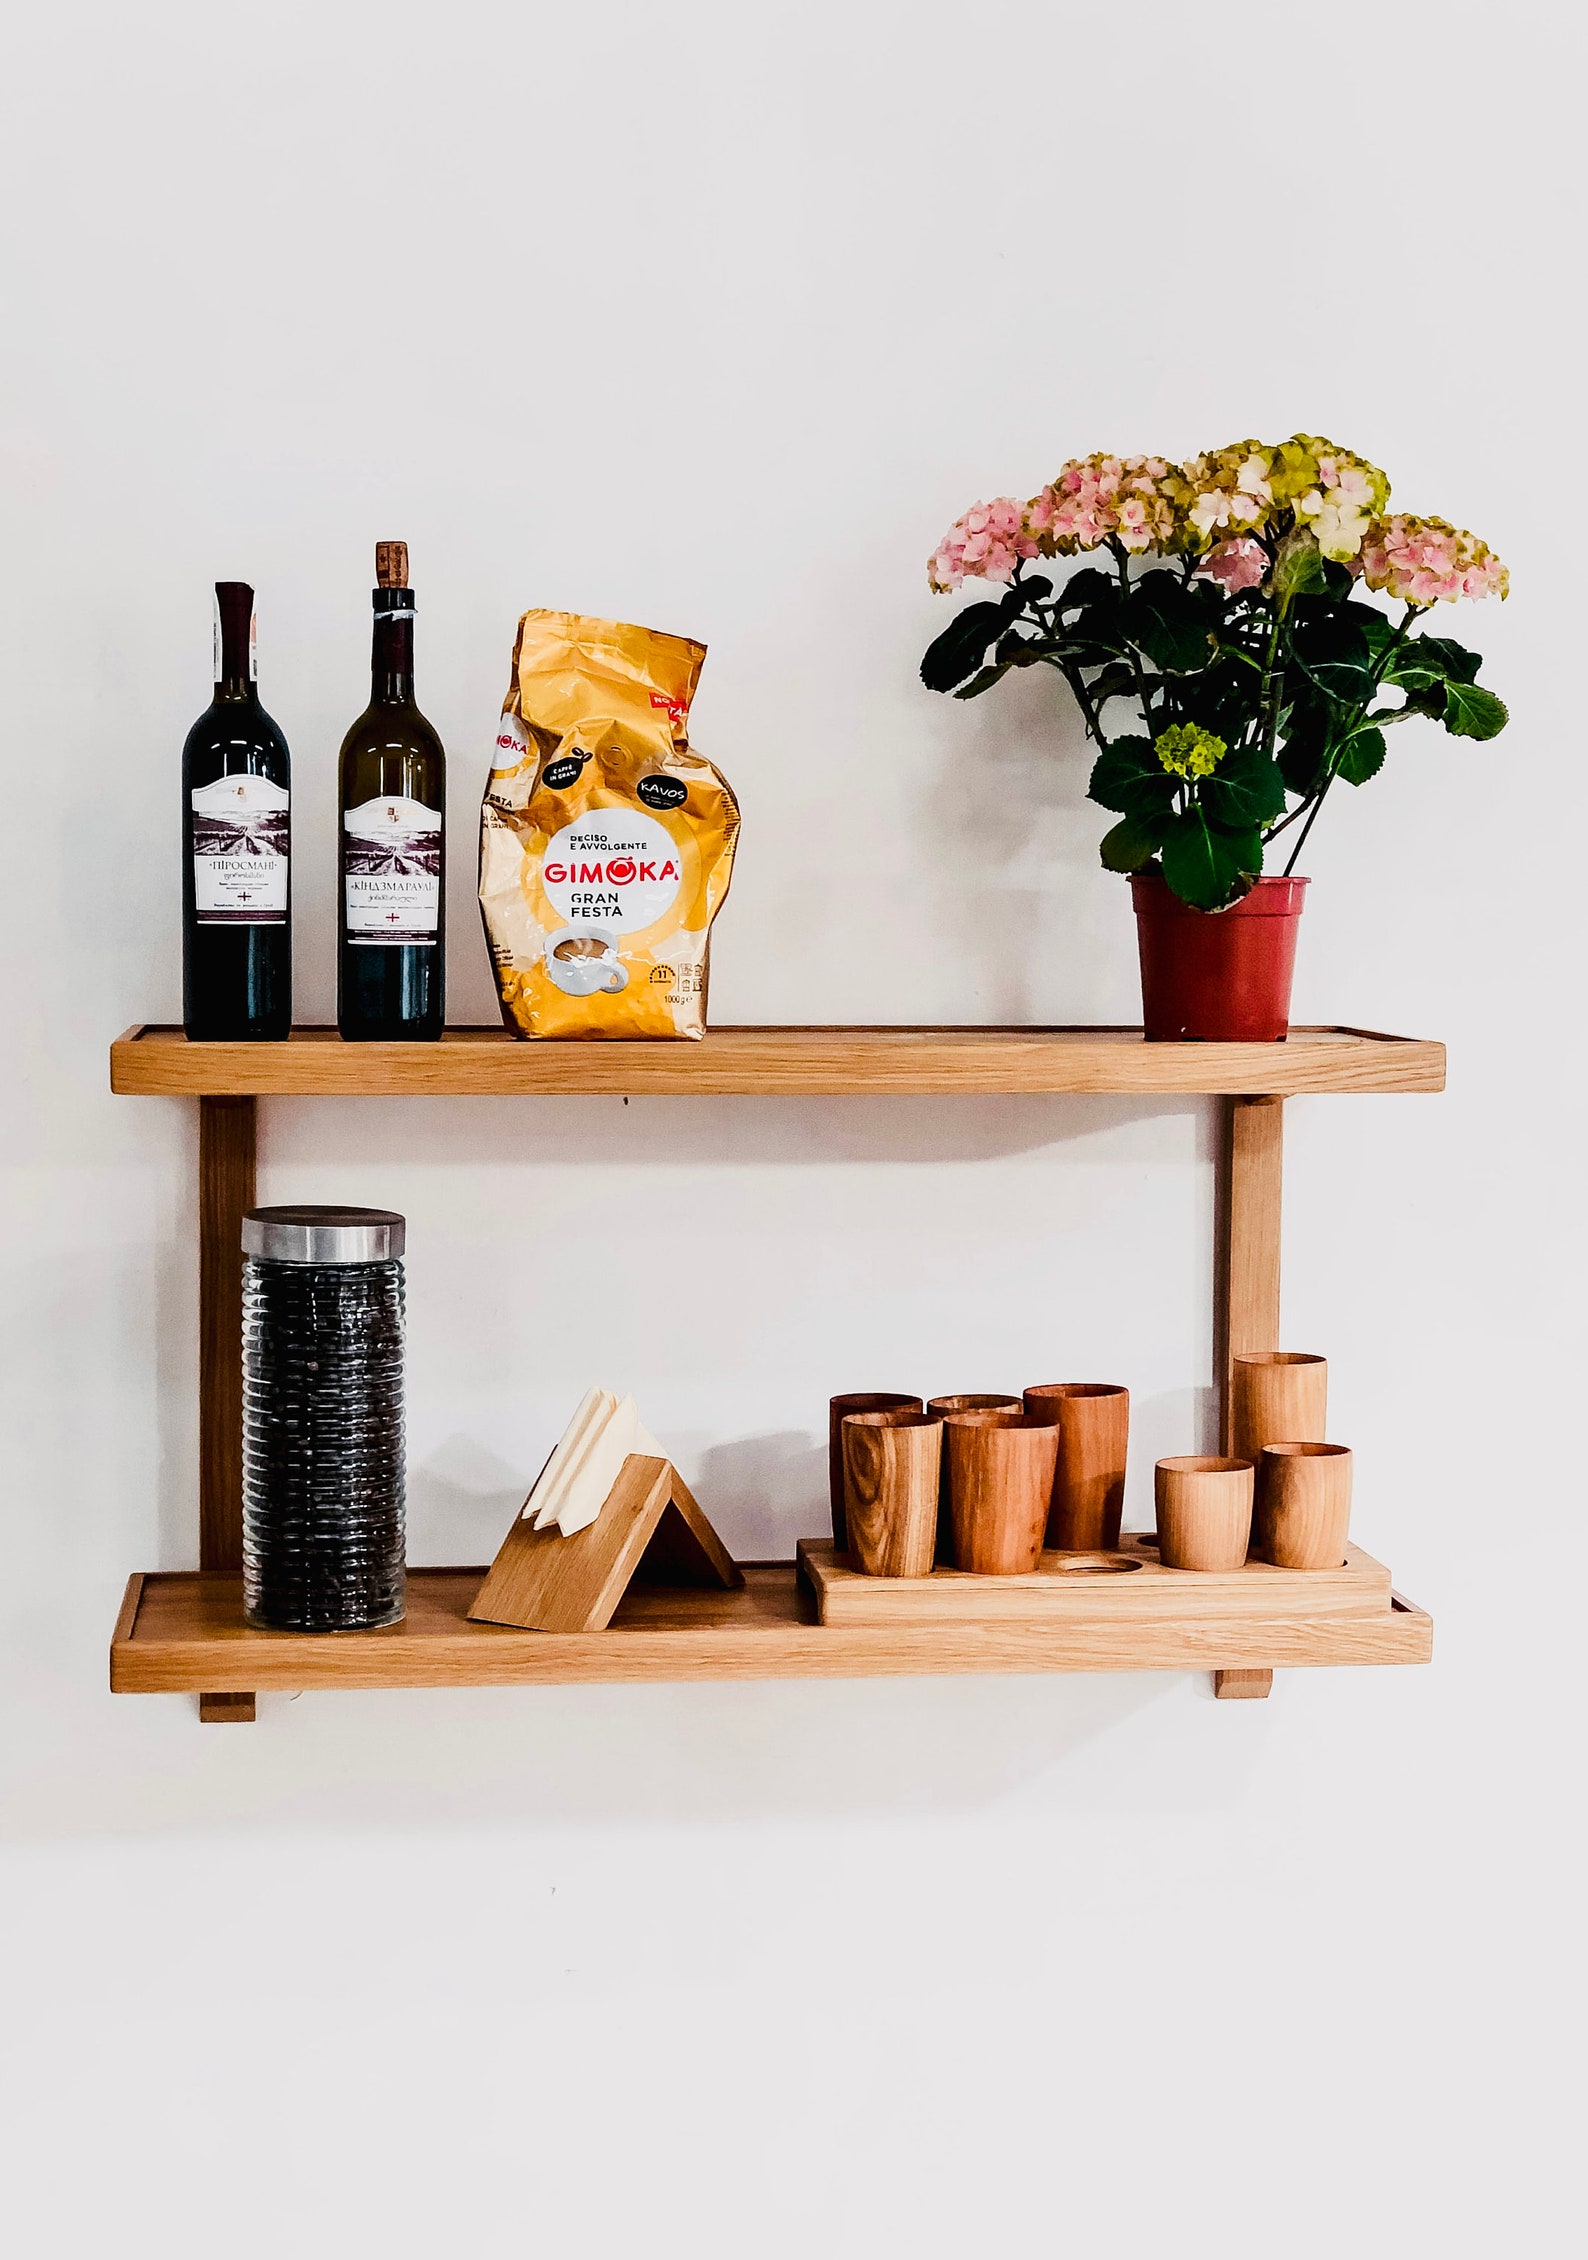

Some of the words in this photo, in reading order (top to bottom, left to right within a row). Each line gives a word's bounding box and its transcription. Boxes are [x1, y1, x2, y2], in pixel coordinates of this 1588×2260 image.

[641, 782, 685, 800] KAVOS
[486, 792, 513, 808] ESTA
[570, 834, 608, 843] DECISO
[570, 843, 577, 851] E
[580, 842, 648, 851] AVVOLGENTE
[571, 892, 619, 904] GRAN
[571, 906, 623, 918] FESTA
[664, 995, 680, 1004] 1000
